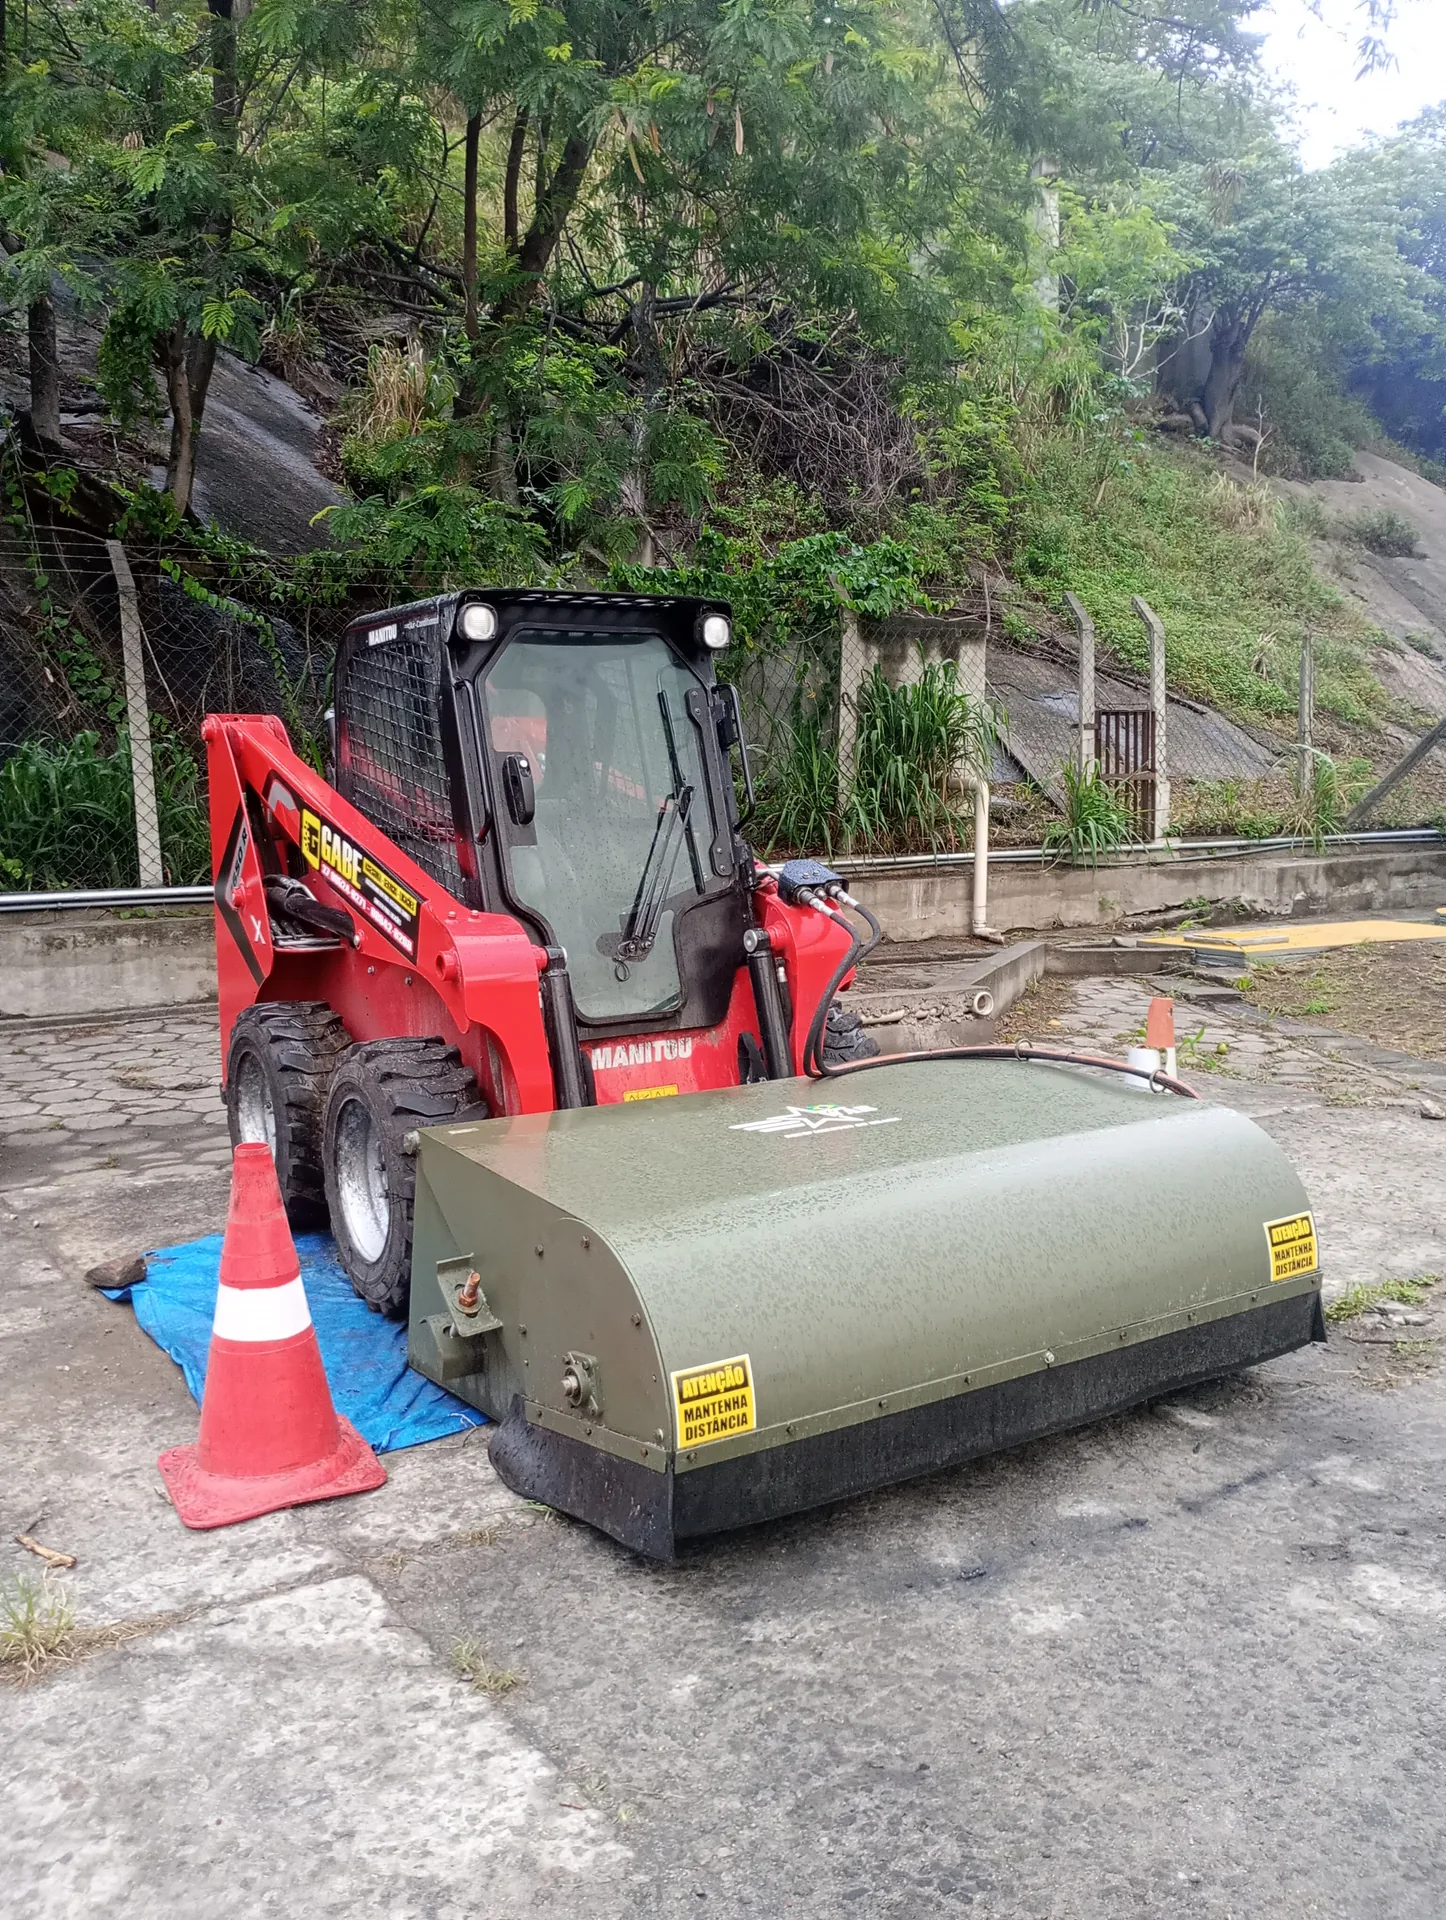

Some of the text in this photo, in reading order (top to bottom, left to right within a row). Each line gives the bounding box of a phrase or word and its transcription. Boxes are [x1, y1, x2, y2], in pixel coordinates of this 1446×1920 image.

[368, 623, 398, 646] MANITOU
[321, 825, 362, 889] GABE
[592, 1037, 692, 1071] MANITOU
[1271, 1219, 1310, 1243] ATENÇÃO
[1274, 1241, 1313, 1262] MANTENHA
[1275, 1256, 1313, 1276] DISTÂNCIA
[682, 1365, 745, 1399] ATENÇÃO
[684, 1394, 748, 1423] MANTENHA
[685, 1412, 748, 1441] DISTÂNCIA
